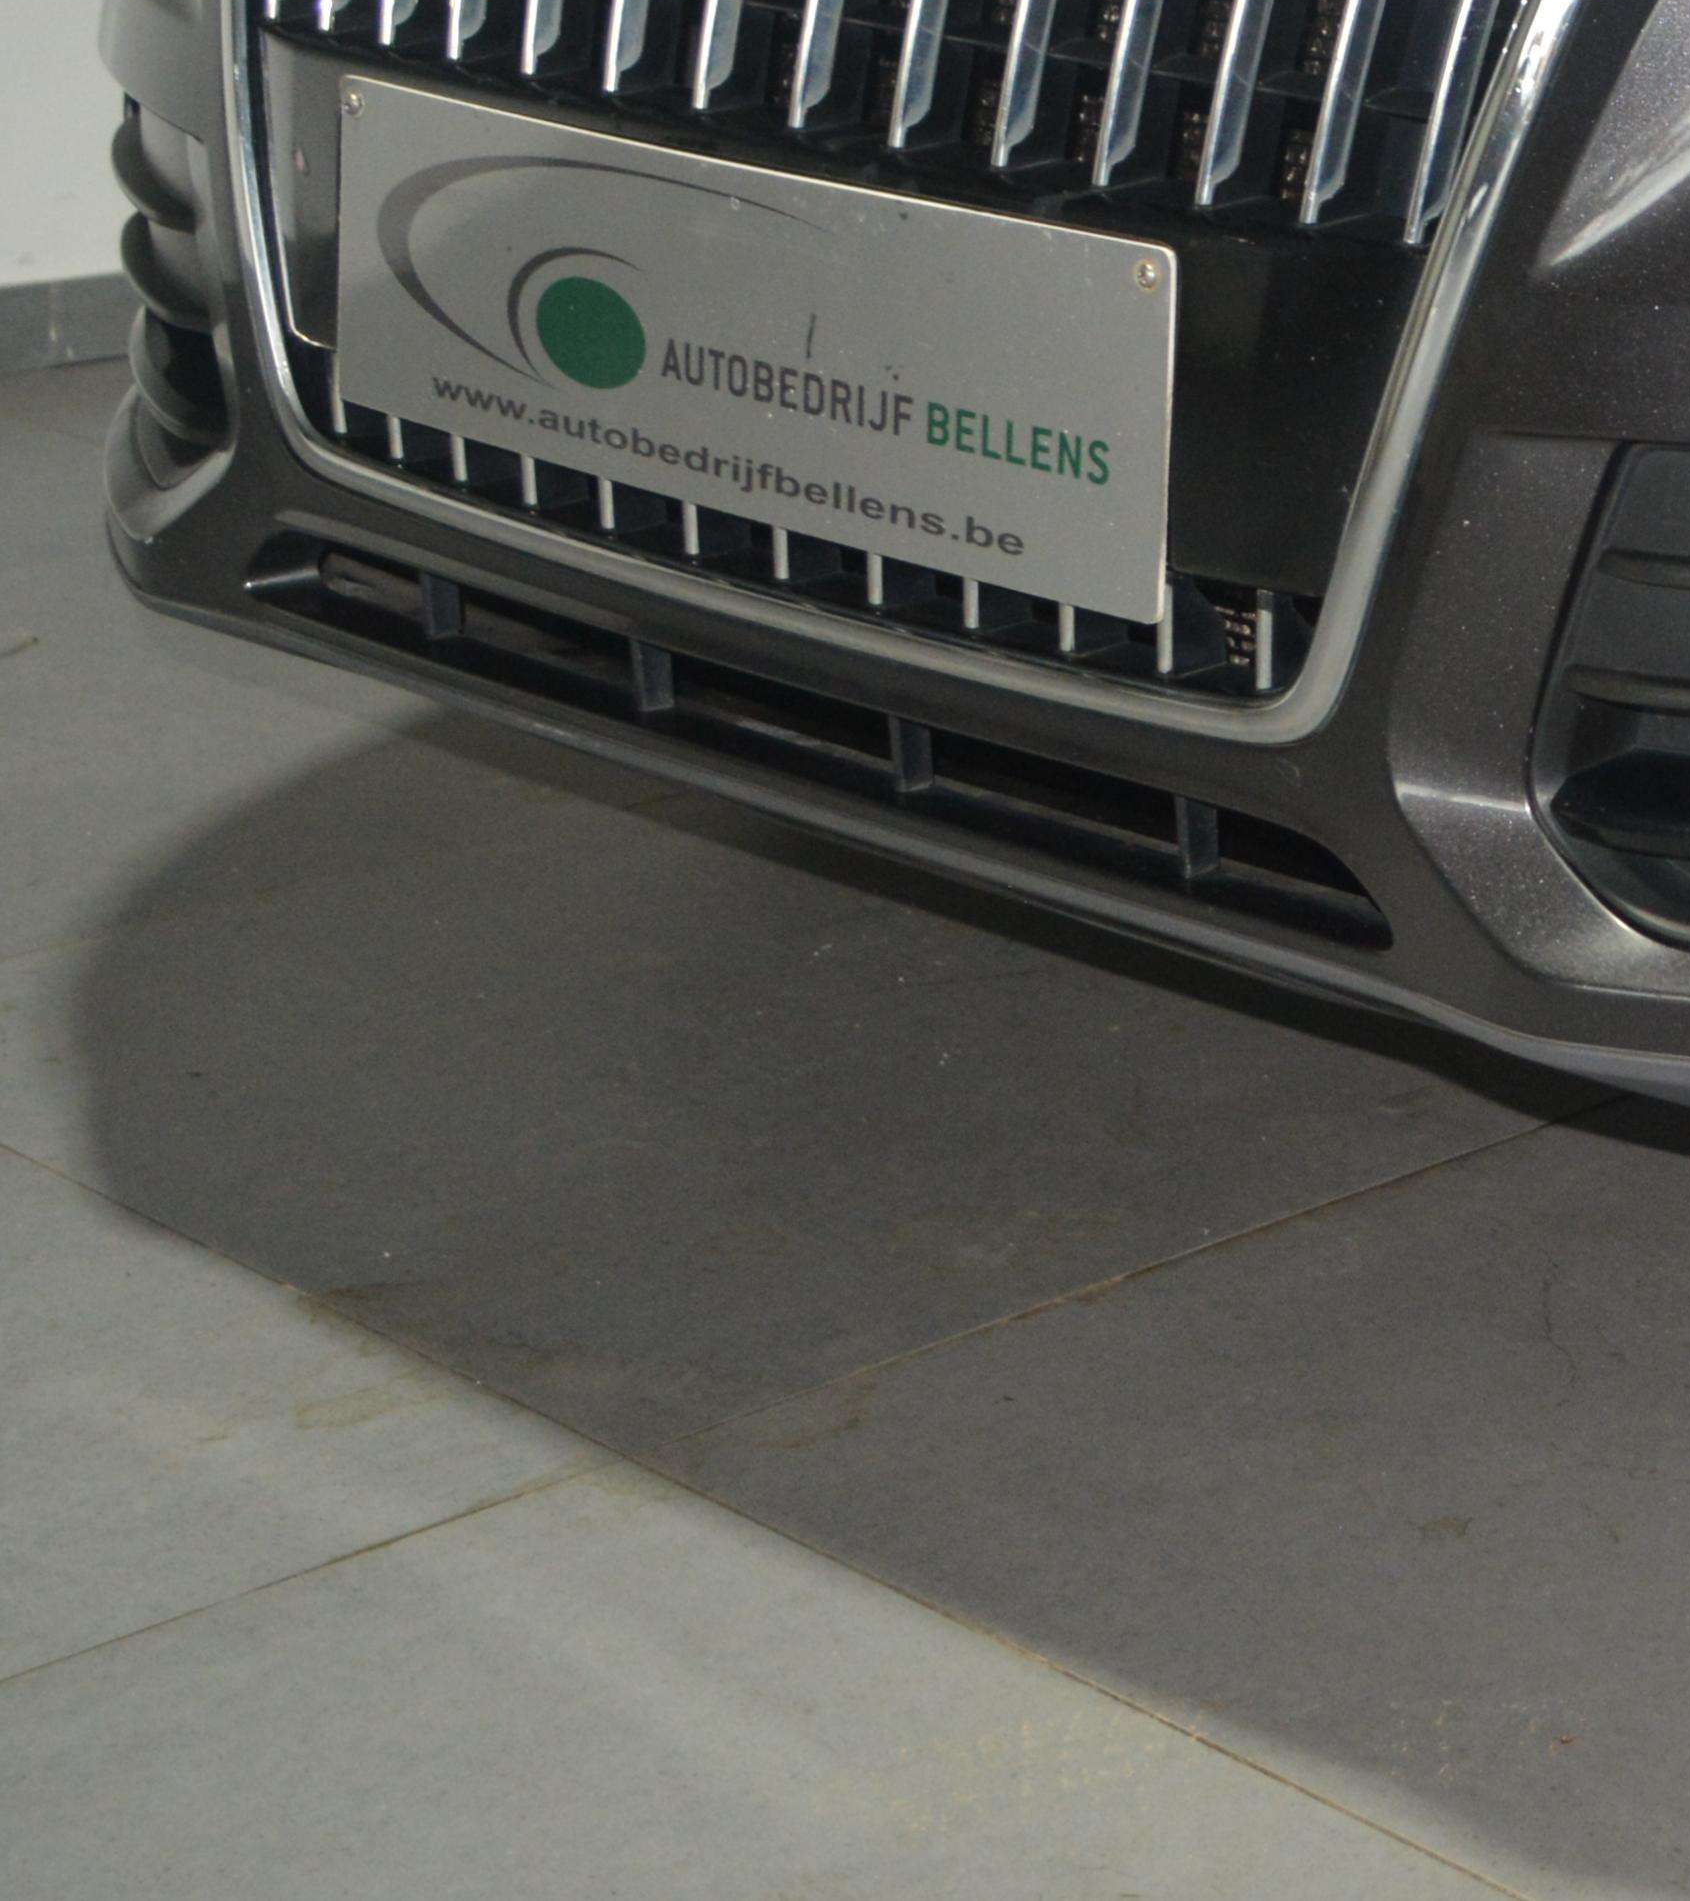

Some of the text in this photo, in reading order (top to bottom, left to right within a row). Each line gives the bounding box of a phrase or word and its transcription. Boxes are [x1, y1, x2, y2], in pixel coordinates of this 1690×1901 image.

[431, 376, 1025, 556] www.autobedrijfbellens.be
[661, 338, 1110, 486] AUTOBEDRIJF BELLENS
